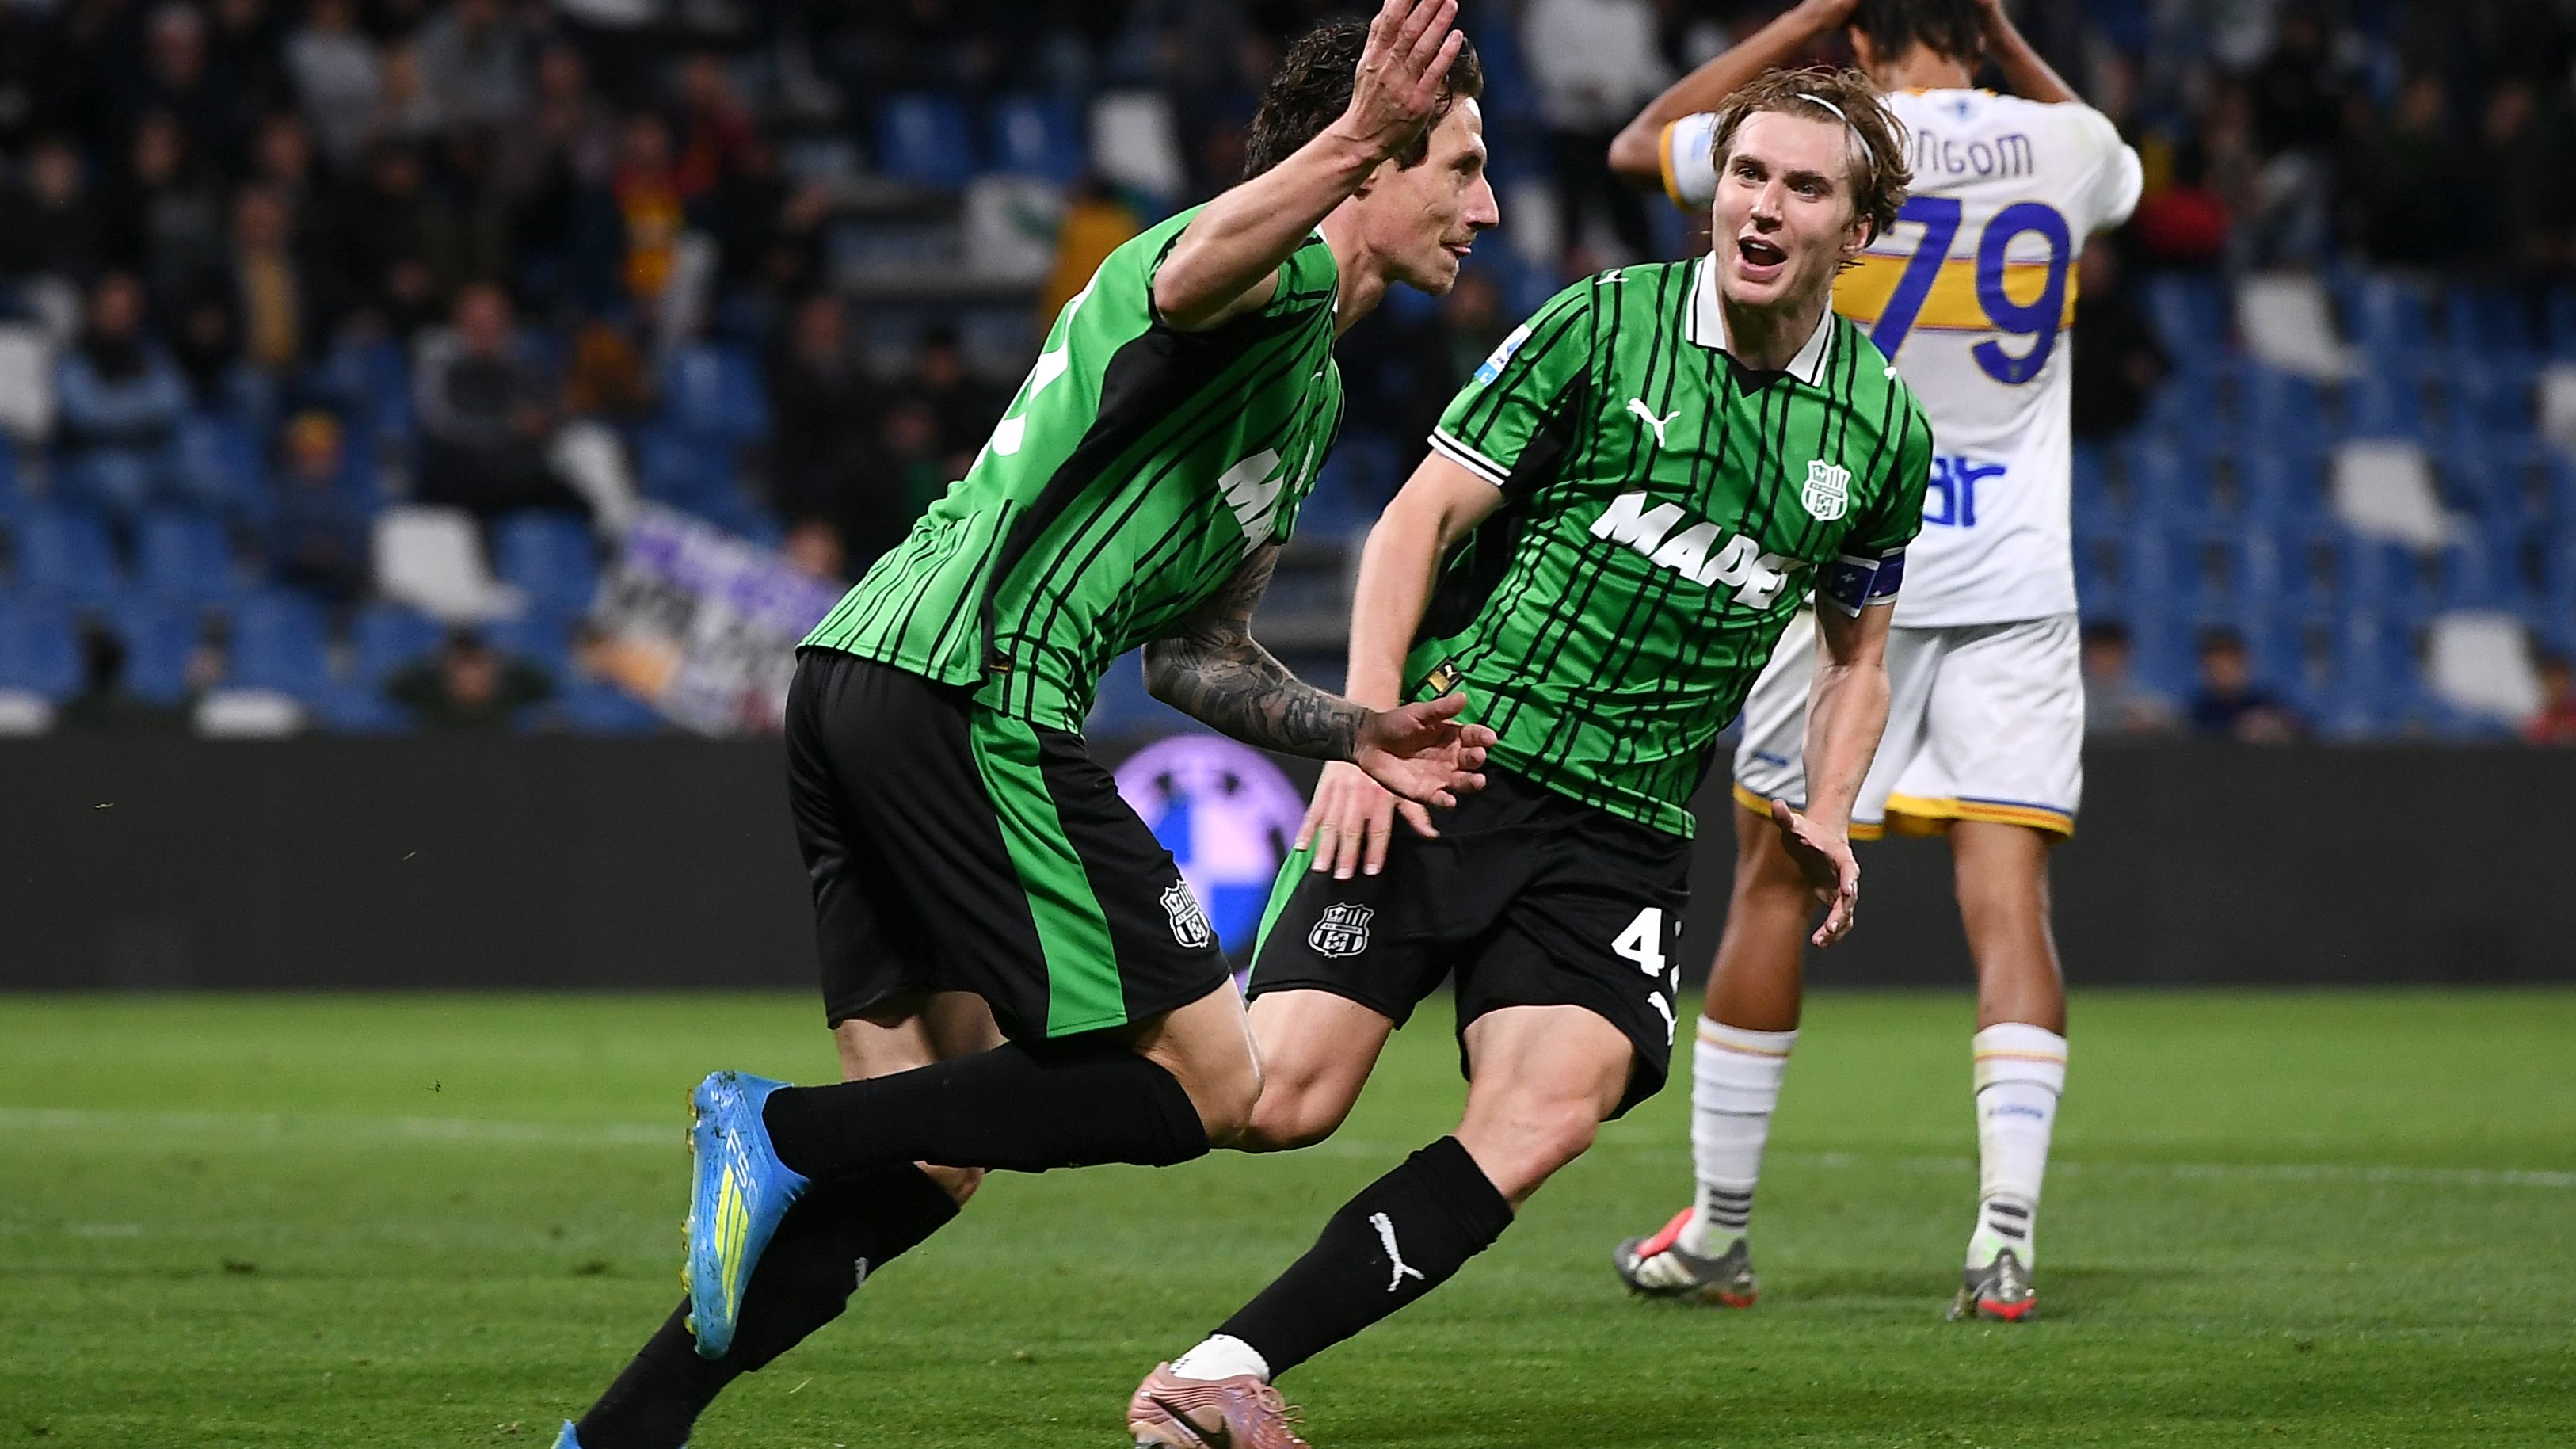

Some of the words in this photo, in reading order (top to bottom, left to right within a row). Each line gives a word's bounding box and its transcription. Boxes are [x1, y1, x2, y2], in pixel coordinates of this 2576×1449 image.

[1871, 196, 2071, 385] 79
[1588, 490, 1809, 610] MAPE
[1610, 907, 1682, 996] 4
